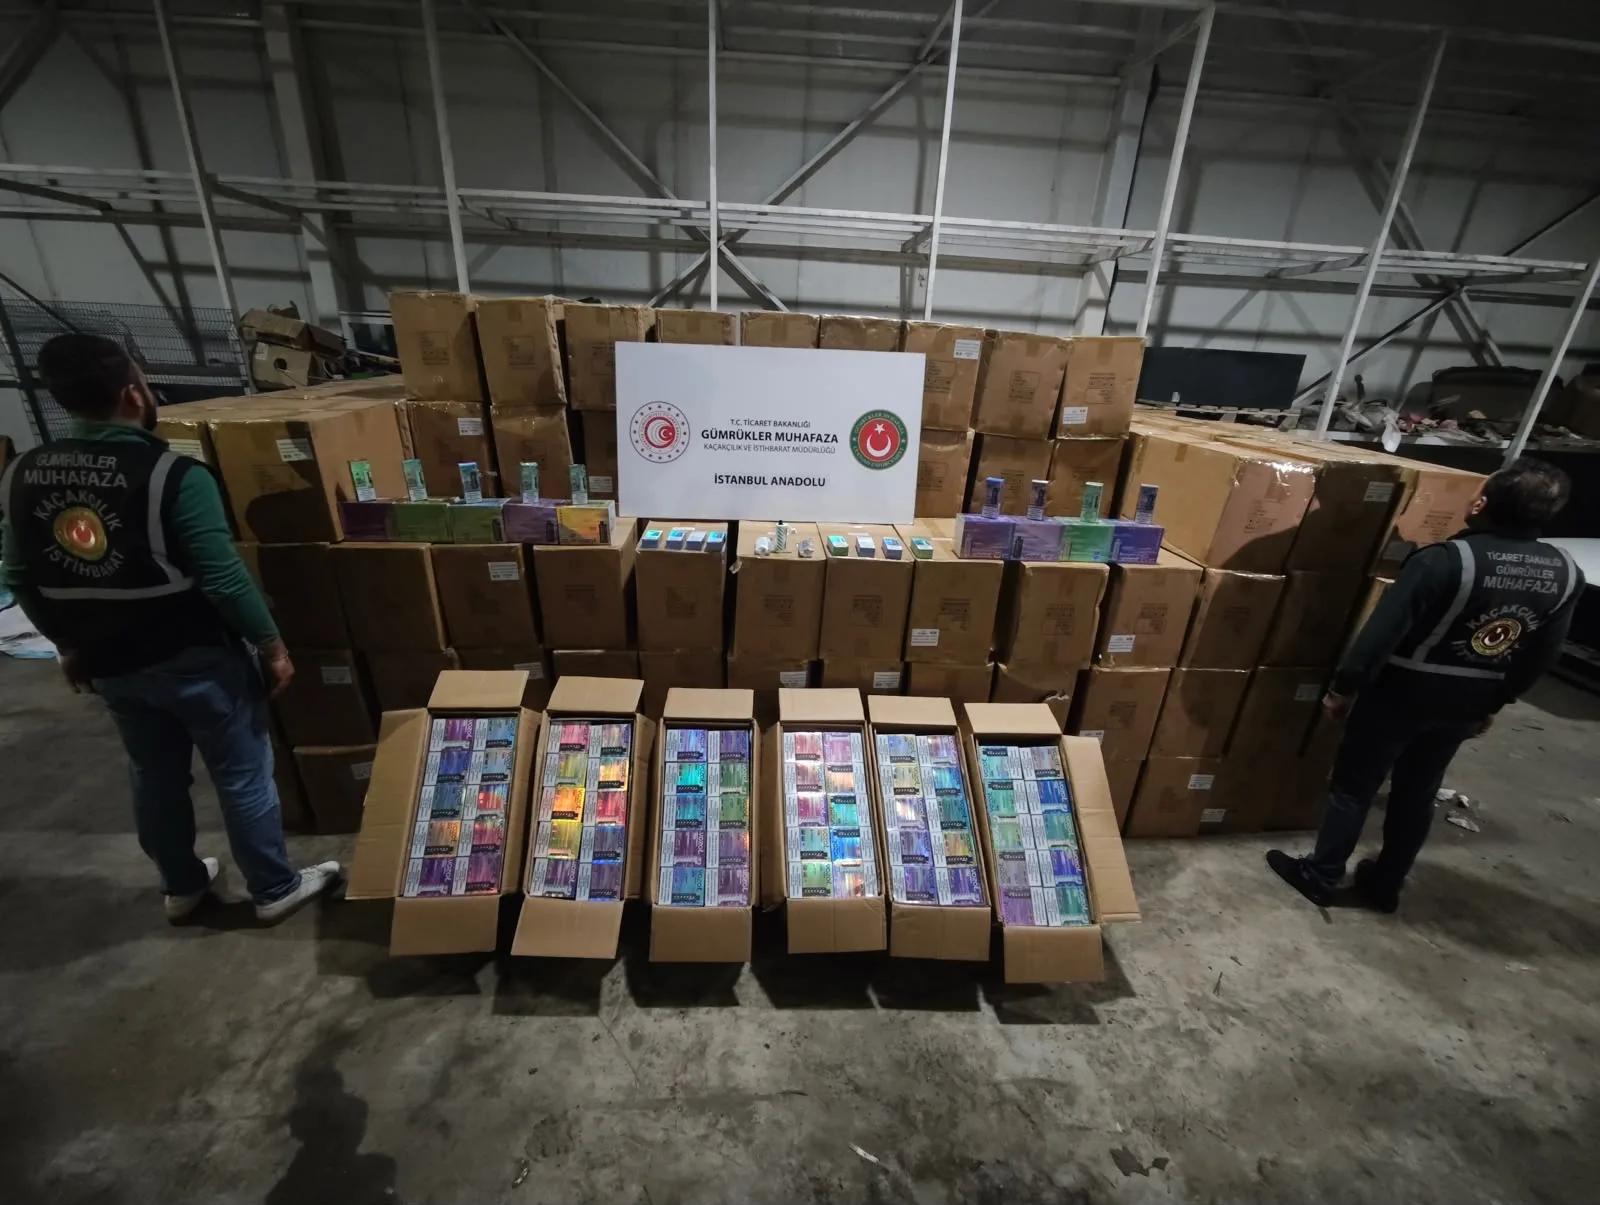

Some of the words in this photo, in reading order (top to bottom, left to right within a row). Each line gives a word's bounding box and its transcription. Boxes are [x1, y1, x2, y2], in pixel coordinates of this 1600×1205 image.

[730, 418, 742, 426] T.C.
[744, 418, 772, 427] TİCARET
[773, 420, 811, 428] BAKANLIĞI
[701, 428, 772, 441] GÜMRÜKLER
[775, 432, 839, 444] MUHAFAZA
[703, 443, 742, 452] KAÇAKÇILIK
[744, 444, 752, 452] VE
[753, 444, 790, 453] İSTİHBARAT
[792, 445, 836, 455] MÜDÜRLÜĞÜ
[24, 469, 128, 488] MUHAFAZA
[714, 473, 768, 486] İSTANBUL
[770, 476, 826, 487] ANADOLU
[1486, 550, 1524, 562] TİCARET
[1483, 576, 1559, 595] MUHAFAZA
